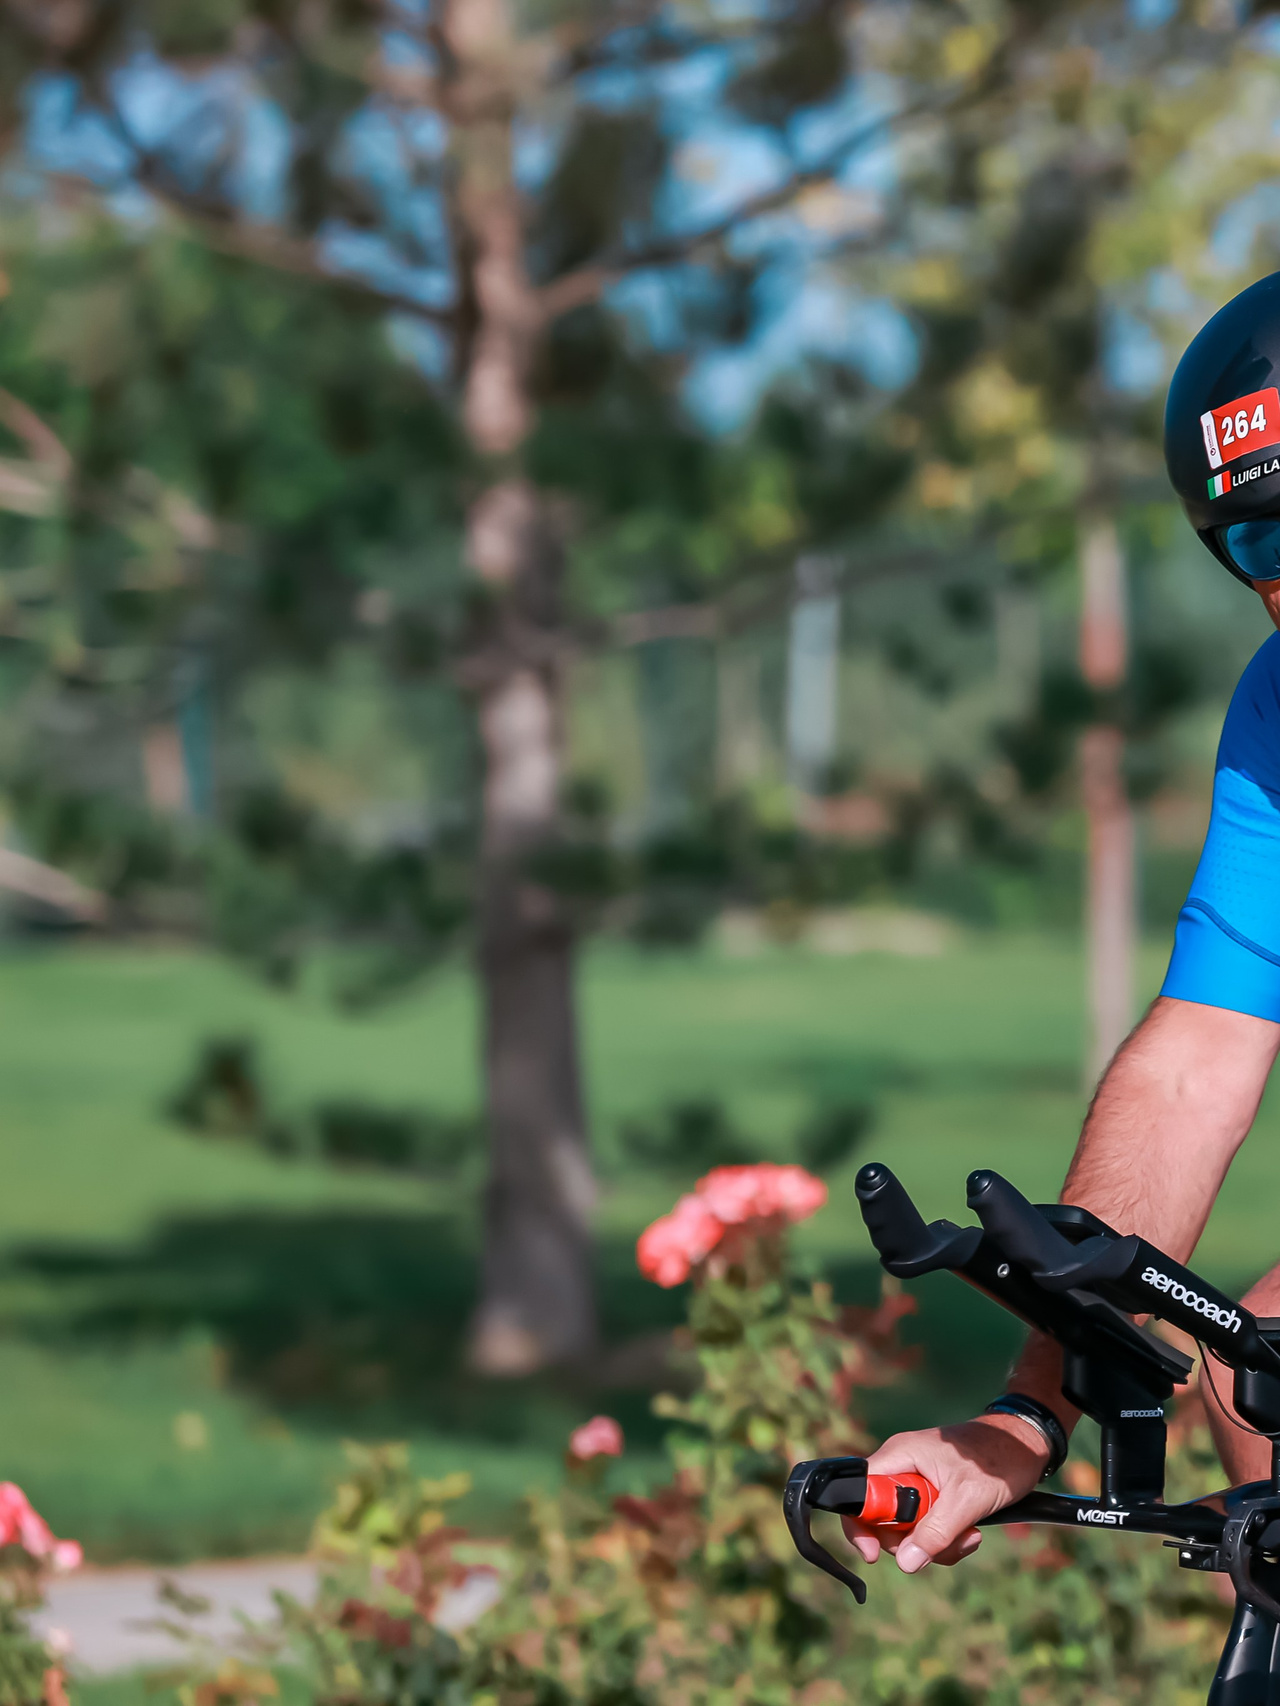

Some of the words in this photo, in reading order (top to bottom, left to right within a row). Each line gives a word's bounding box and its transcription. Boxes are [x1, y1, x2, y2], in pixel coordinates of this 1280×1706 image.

[1221, 403, 1267, 446] 264
[1232, 465, 1261, 487] LUIGI
[1140, 1266, 1243, 1334] aerocoach
